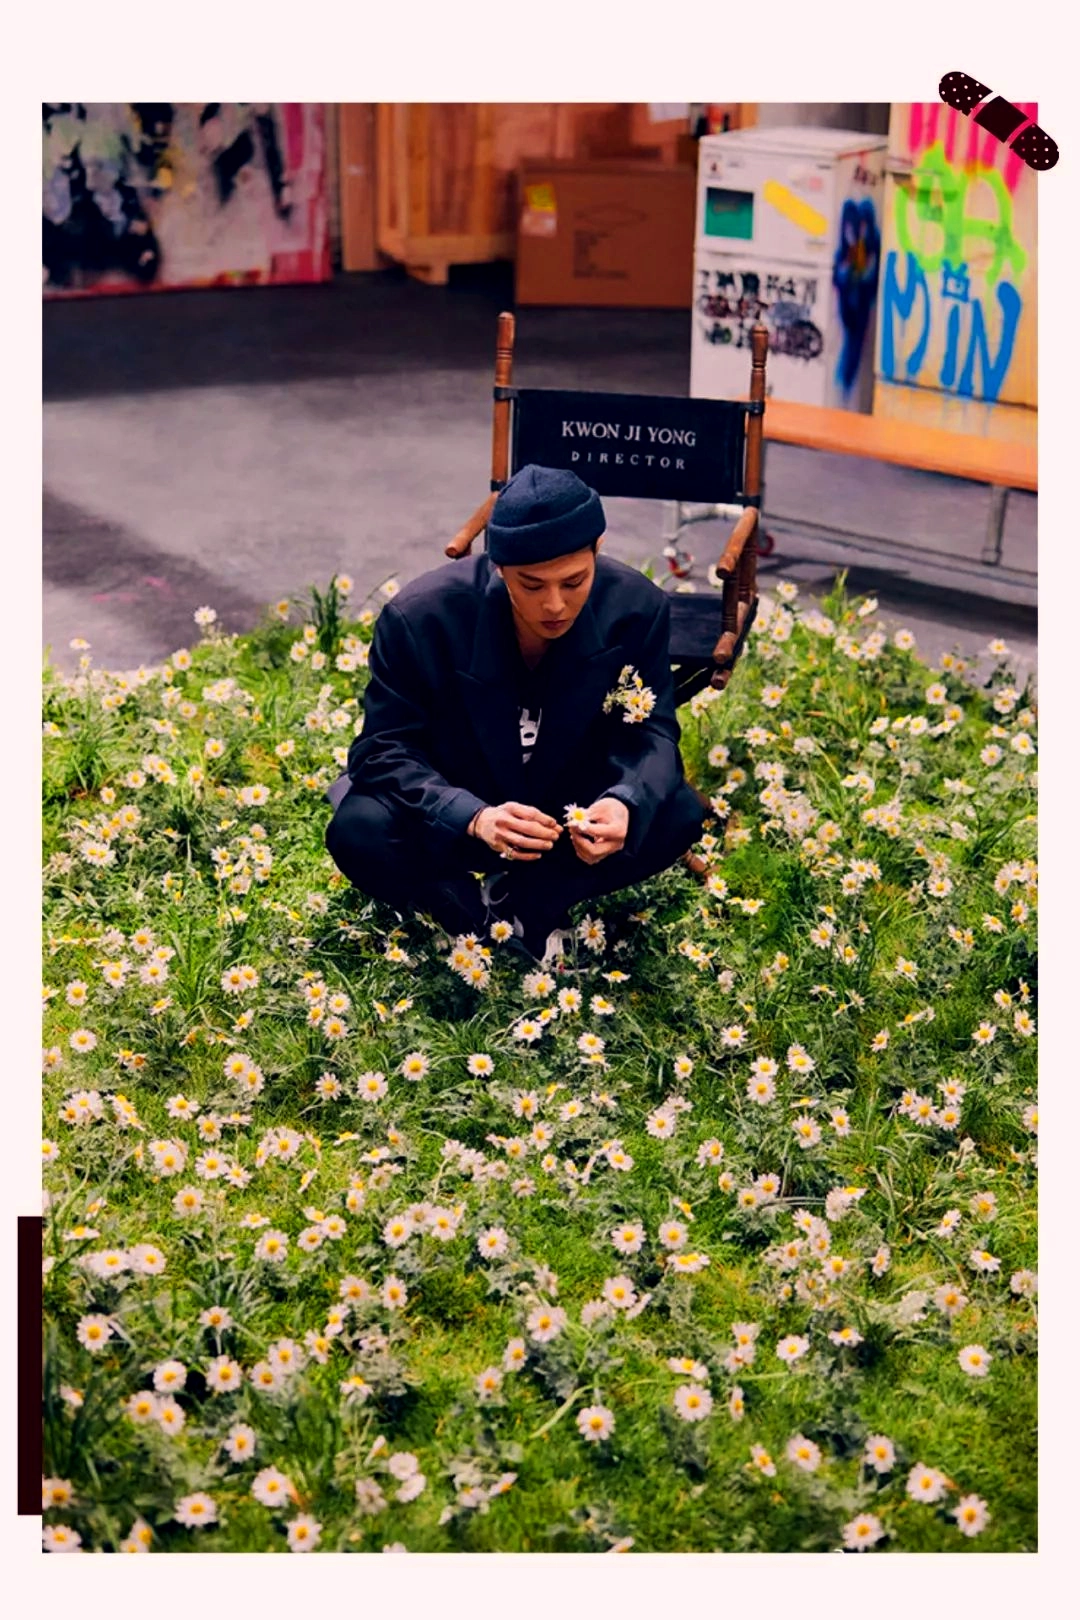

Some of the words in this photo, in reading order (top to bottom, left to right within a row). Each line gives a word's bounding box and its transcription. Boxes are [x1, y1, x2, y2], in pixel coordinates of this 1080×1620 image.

[561, 420, 620, 439] KWON
[624, 425, 641, 441] JI
[647, 426, 697, 447] YONG
[571, 451, 686, 470] DIRECTOR
